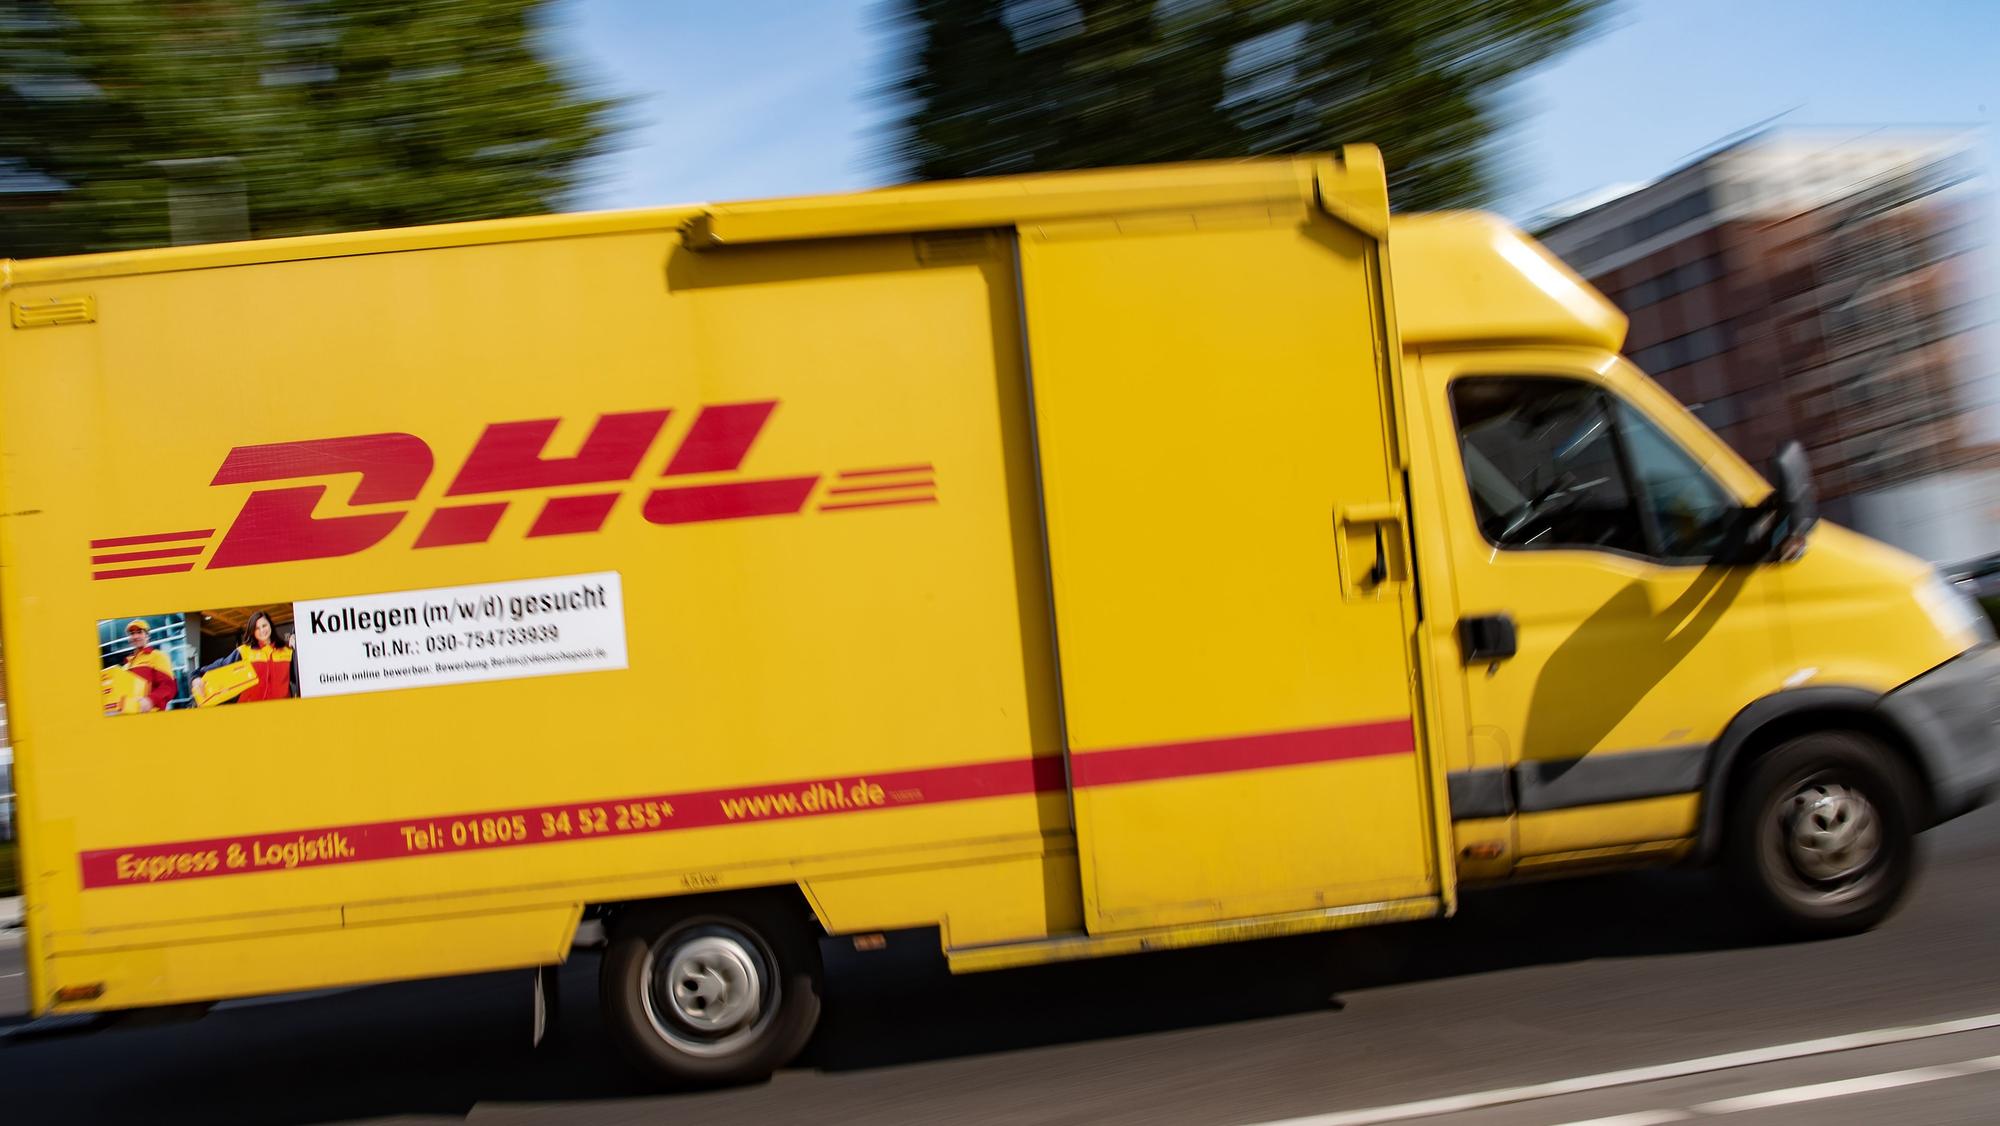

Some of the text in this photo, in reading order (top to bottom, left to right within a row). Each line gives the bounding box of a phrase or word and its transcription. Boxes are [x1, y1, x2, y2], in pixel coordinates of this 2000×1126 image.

[206, 399, 819, 570] DHL
[310, 585, 606, 634] Kollegen (m/w/d) gesucht
[363, 625, 559, 659] Tel.Nr.: 030-754733939
[319, 672, 349, 684] Gleich
[351, 669, 380, 681] online
[720, 779, 886, 820] www.dhl.de
[401, 823, 444, 851] Tel:
[451, 815, 527, 845] 01805
[541, 810, 572, 837] 34
[579, 807, 609, 833] 52
[116, 832, 355, 882] Express & Logistik.
